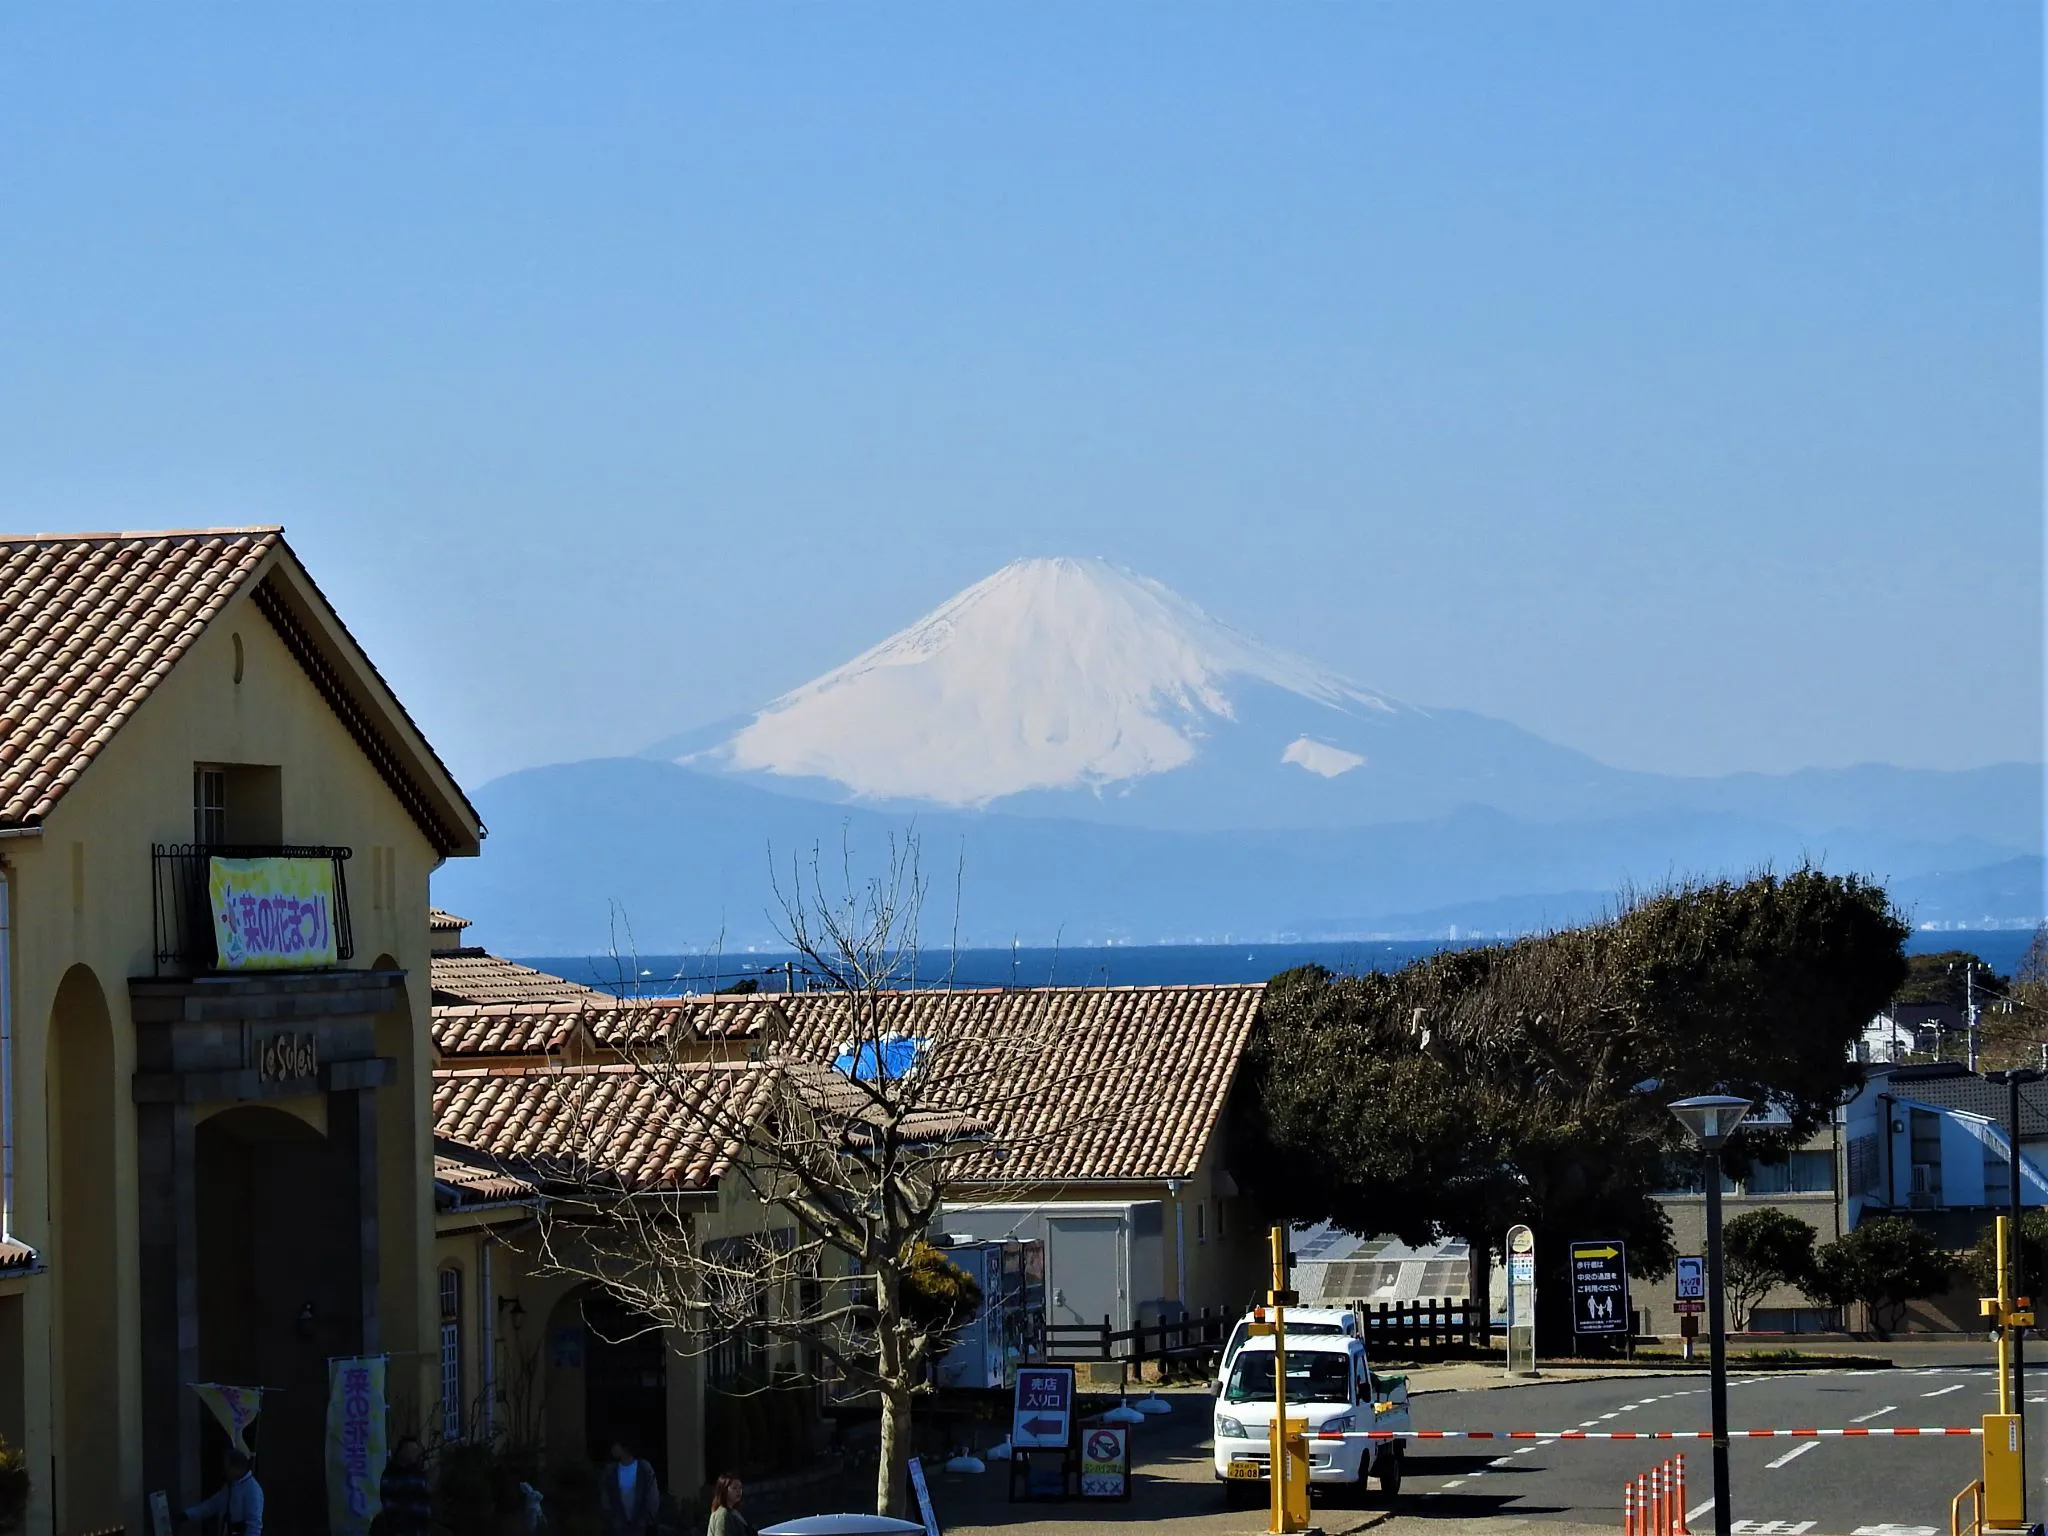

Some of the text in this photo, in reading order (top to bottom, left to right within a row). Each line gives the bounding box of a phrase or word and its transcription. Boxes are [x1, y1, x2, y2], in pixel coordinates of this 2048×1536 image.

[239, 891, 328, 953] 菜の花まつり
[1683, 1286, 1699, 1296] 入口
[1031, 1378, 1057, 1391] 売店
[1026, 1394, 1060, 1407] 入り口
